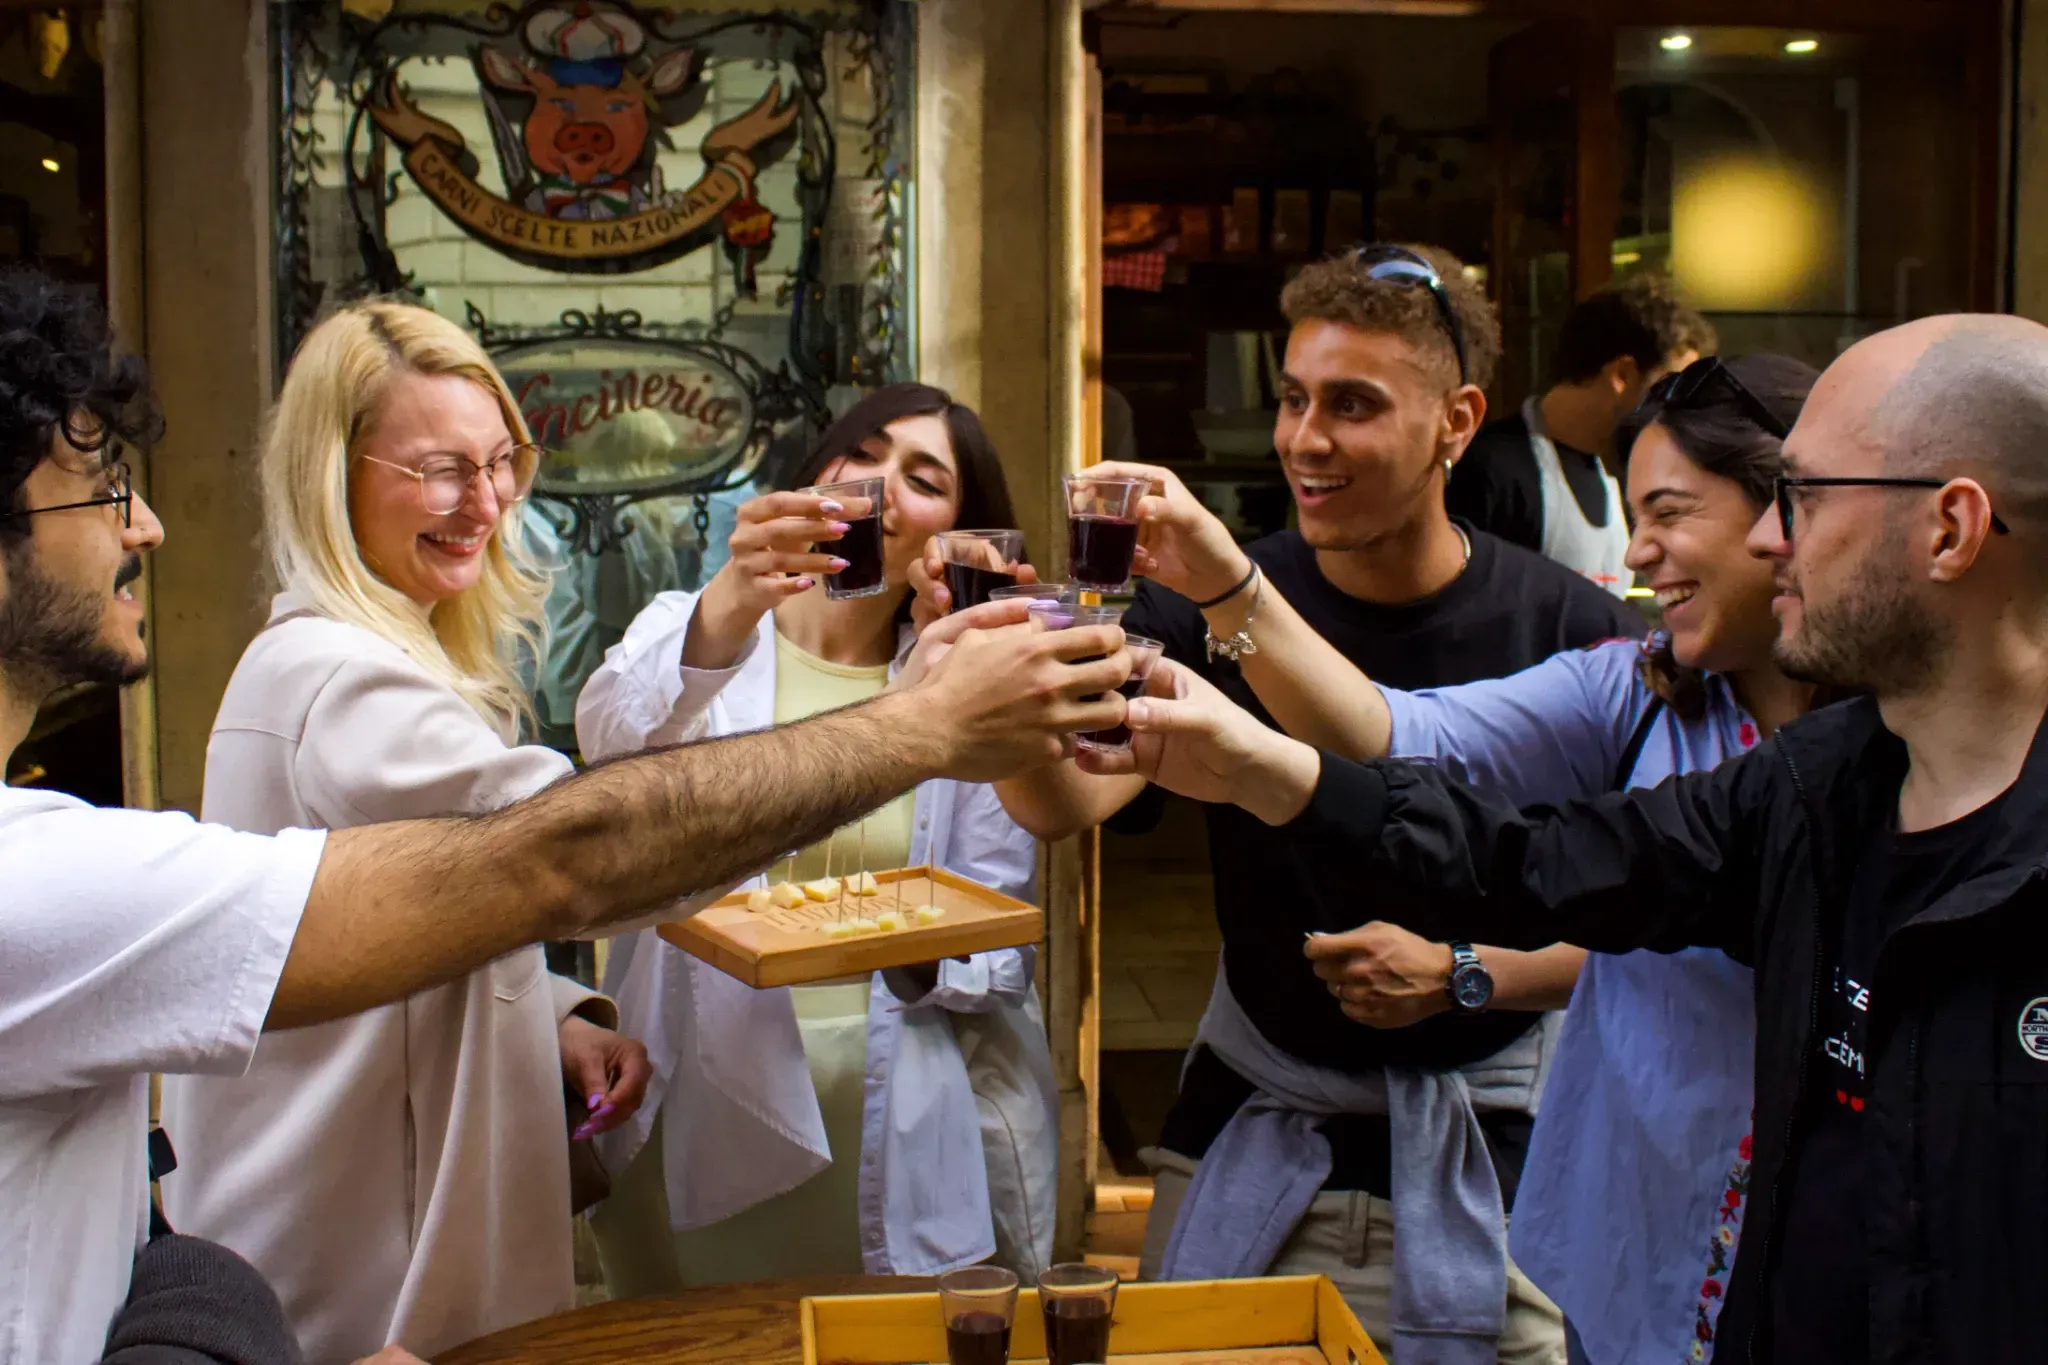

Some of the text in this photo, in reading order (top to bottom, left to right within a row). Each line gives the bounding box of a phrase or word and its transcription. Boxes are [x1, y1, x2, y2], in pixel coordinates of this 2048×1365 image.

[420, 153, 726, 248] CARNI SCELTE NAZIONALI
